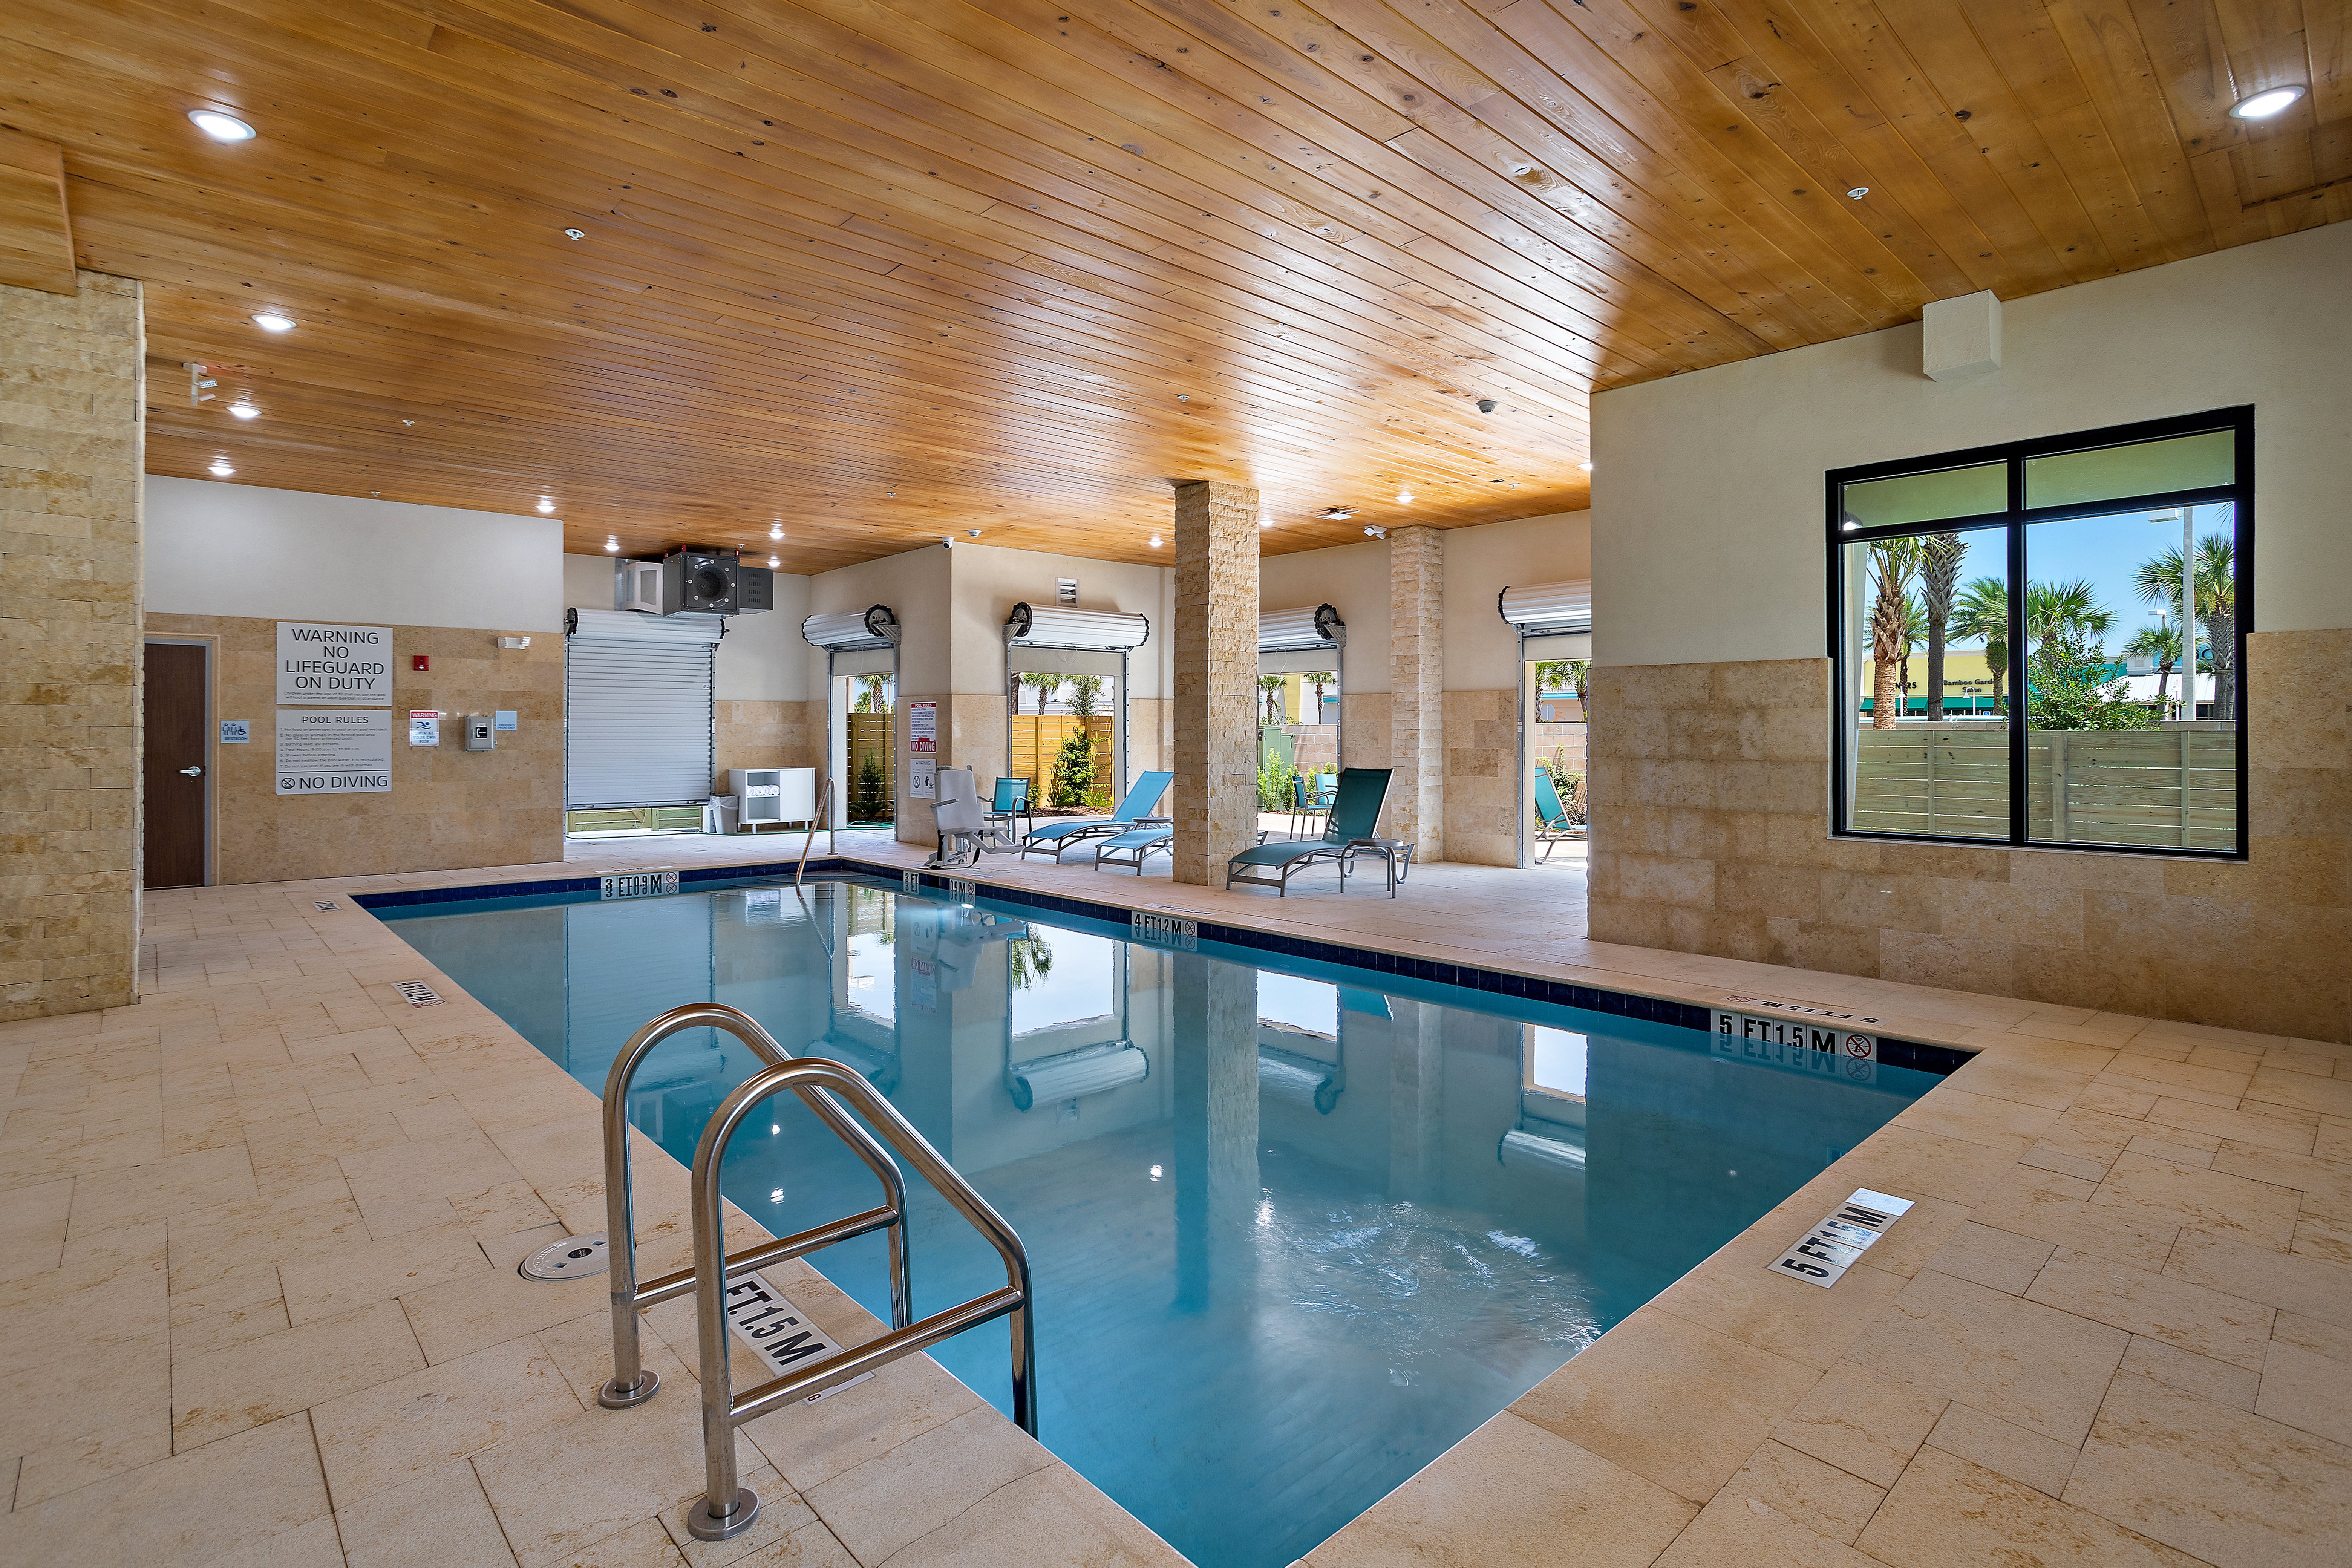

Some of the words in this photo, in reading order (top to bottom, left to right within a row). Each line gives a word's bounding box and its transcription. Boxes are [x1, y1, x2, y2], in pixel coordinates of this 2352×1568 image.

[291, 628, 379, 645] WARNING
[323, 646, 349, 658] NO
[286, 660, 384, 675] LIFEGUARD
[296, 676, 322, 689] ON
[329, 677, 375, 690] DUTY
[912, 742, 919, 751] NO
[920, 742, 935, 752] DIVING
[299, 776, 325, 789] NO
[331, 775, 388, 787] DIVING
[606, 878, 613, 889] 3
[651, 874, 662, 885] M
[905, 872, 909, 883] 3
[959, 882, 966, 893] M
[1135, 914, 1141, 926] 4
[1172, 919, 1182, 934] M
[1720, 1014, 1733, 1035] 5
[1776, 1024, 1804, 1048] 1.5
[1812, 1029, 1836, 1055] M
[1781, 1258, 1830, 1278] 5
[1836, 1206, 1888, 1228] M
[738, 1306, 800, 1338] 1.5
[764, 1330, 828, 1366] M
